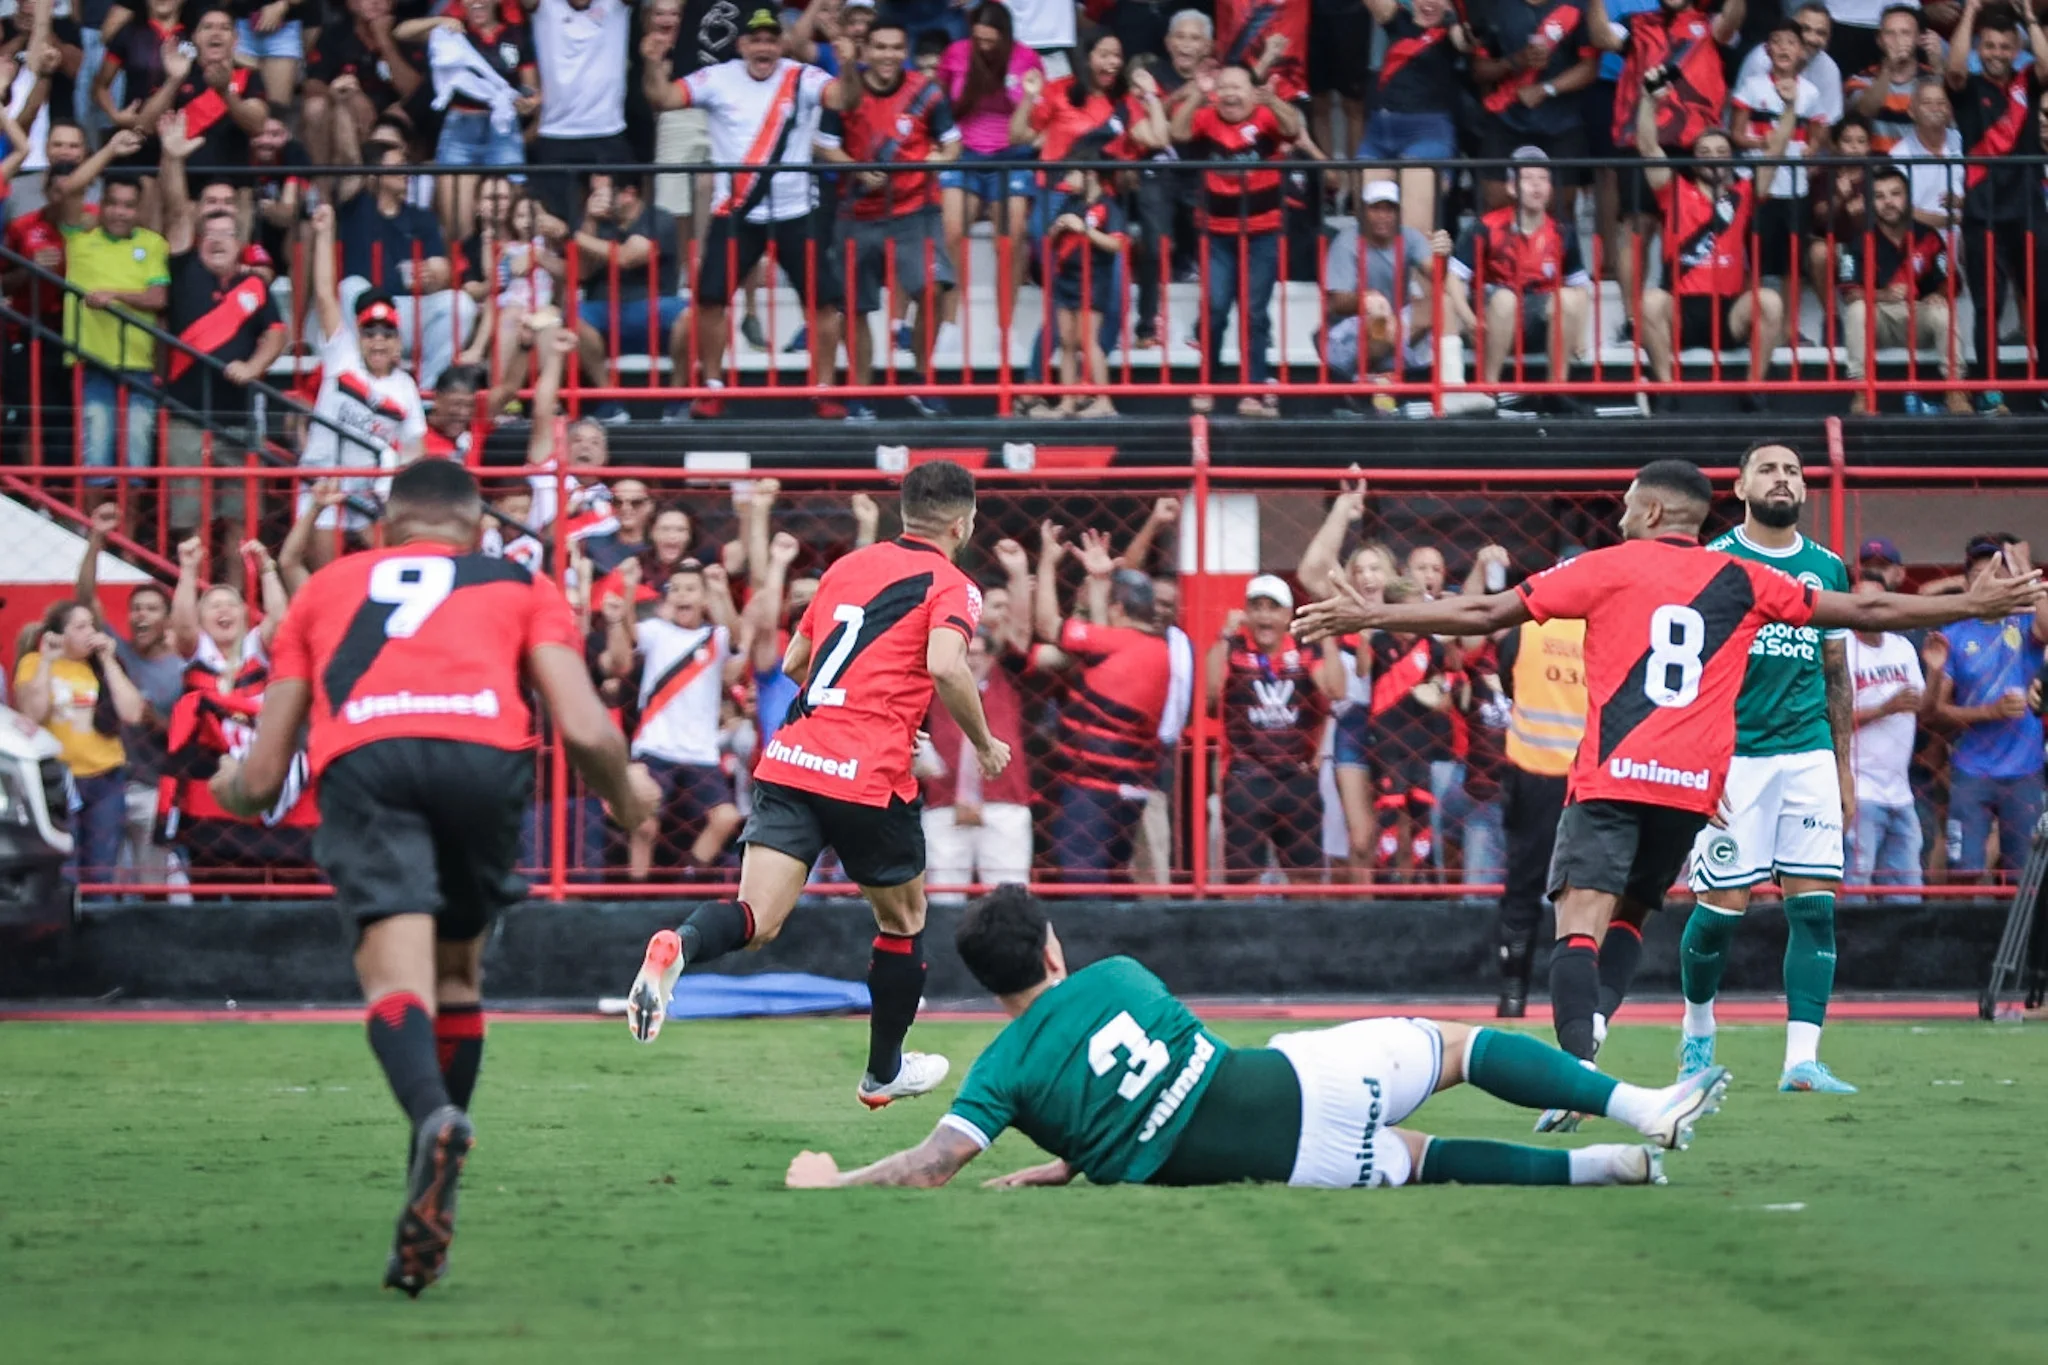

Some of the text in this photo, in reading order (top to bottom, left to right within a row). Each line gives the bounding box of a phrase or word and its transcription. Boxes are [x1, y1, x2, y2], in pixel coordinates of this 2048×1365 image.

[370, 556, 457, 639] 9
[807, 603, 866, 707] 2
[1545, 664, 1588, 688] 03
[1643, 604, 1705, 708] 8
[1765, 638, 1815, 661] Sorte
[345, 688, 499, 725] Unimed
[766, 740, 859, 781] Unimed
[1609, 757, 1710, 791] Unimed
[1088, 1010, 1171, 1101] 3
[1350, 1076, 1381, 1188] nimed
